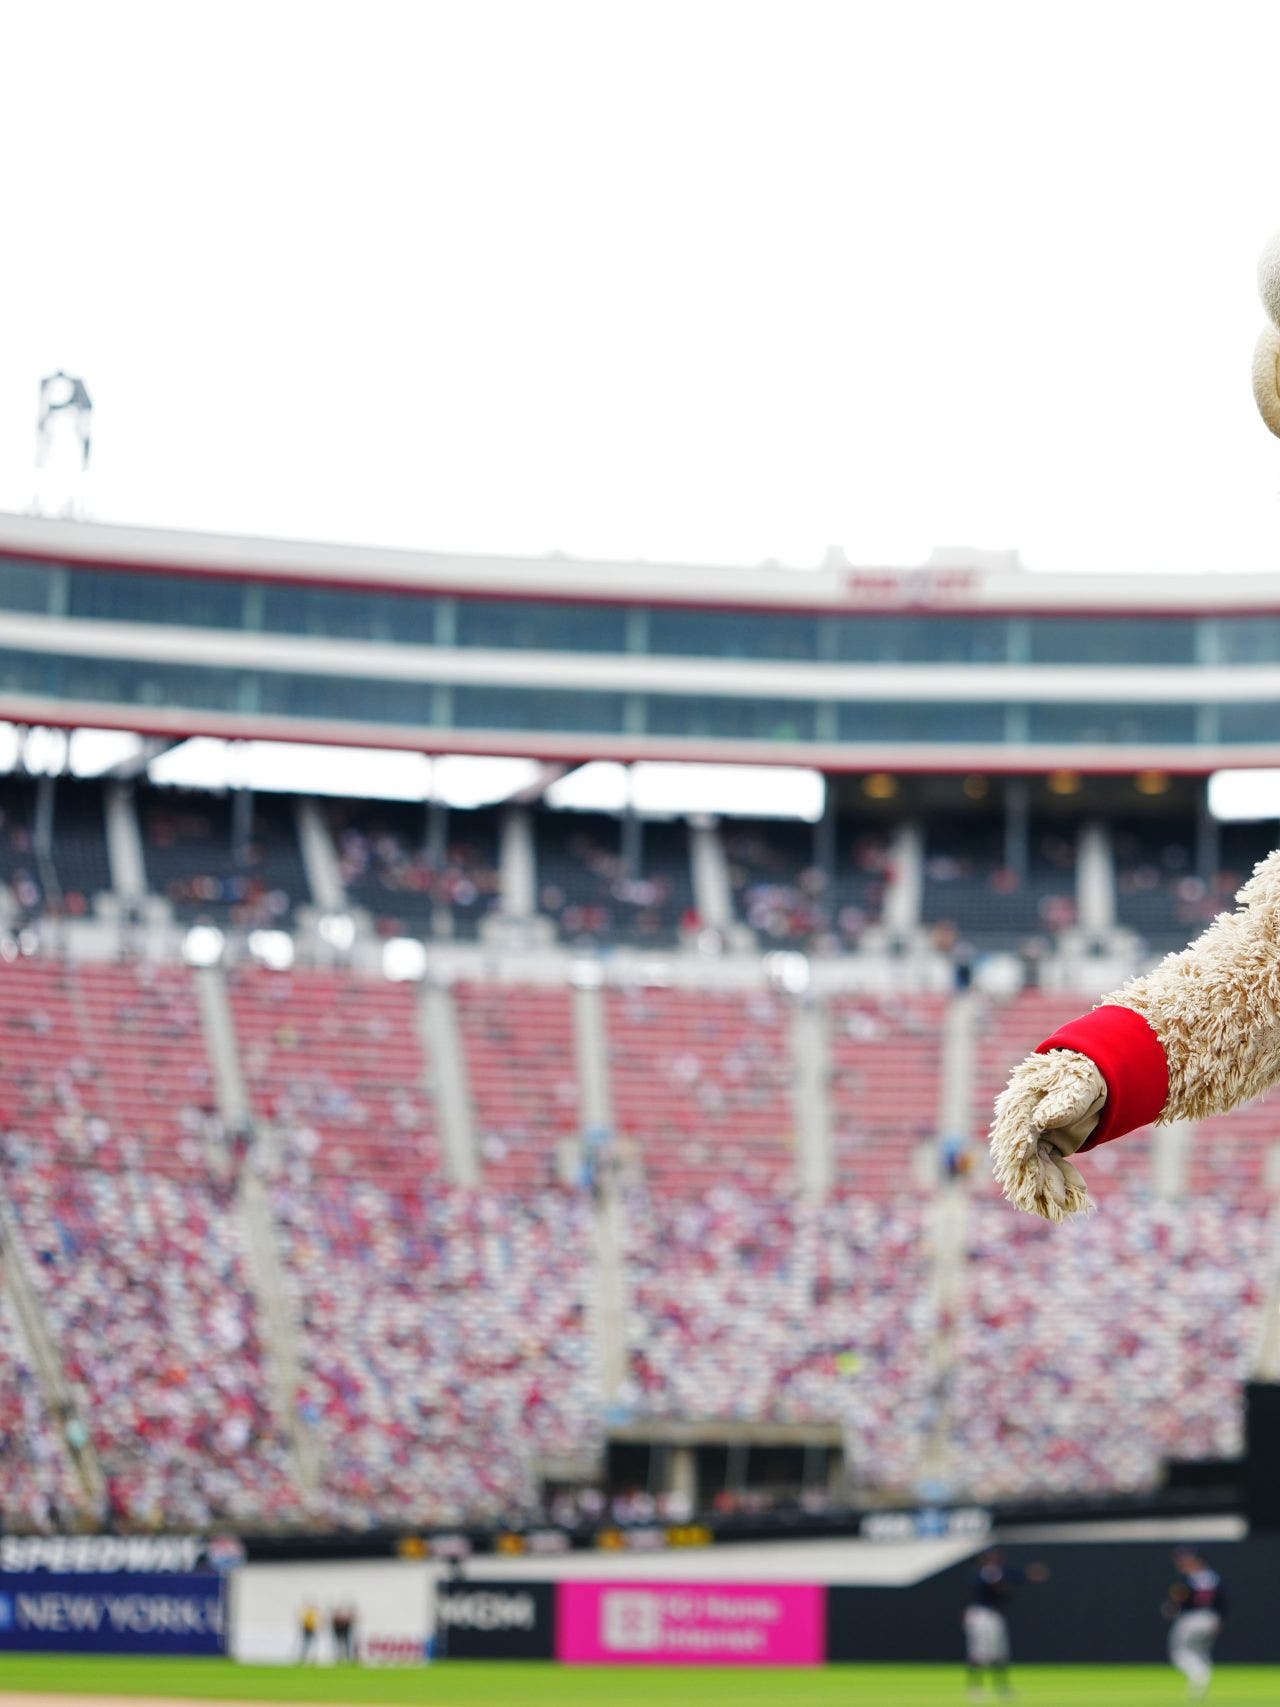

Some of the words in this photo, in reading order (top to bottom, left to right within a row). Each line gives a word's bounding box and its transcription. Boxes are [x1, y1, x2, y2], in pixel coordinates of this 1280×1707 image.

[1, 1535, 203, 1573] SPEEDWAY
[15, 1592, 101, 1633] NEW
[102, 1592, 206, 1635] YORK
